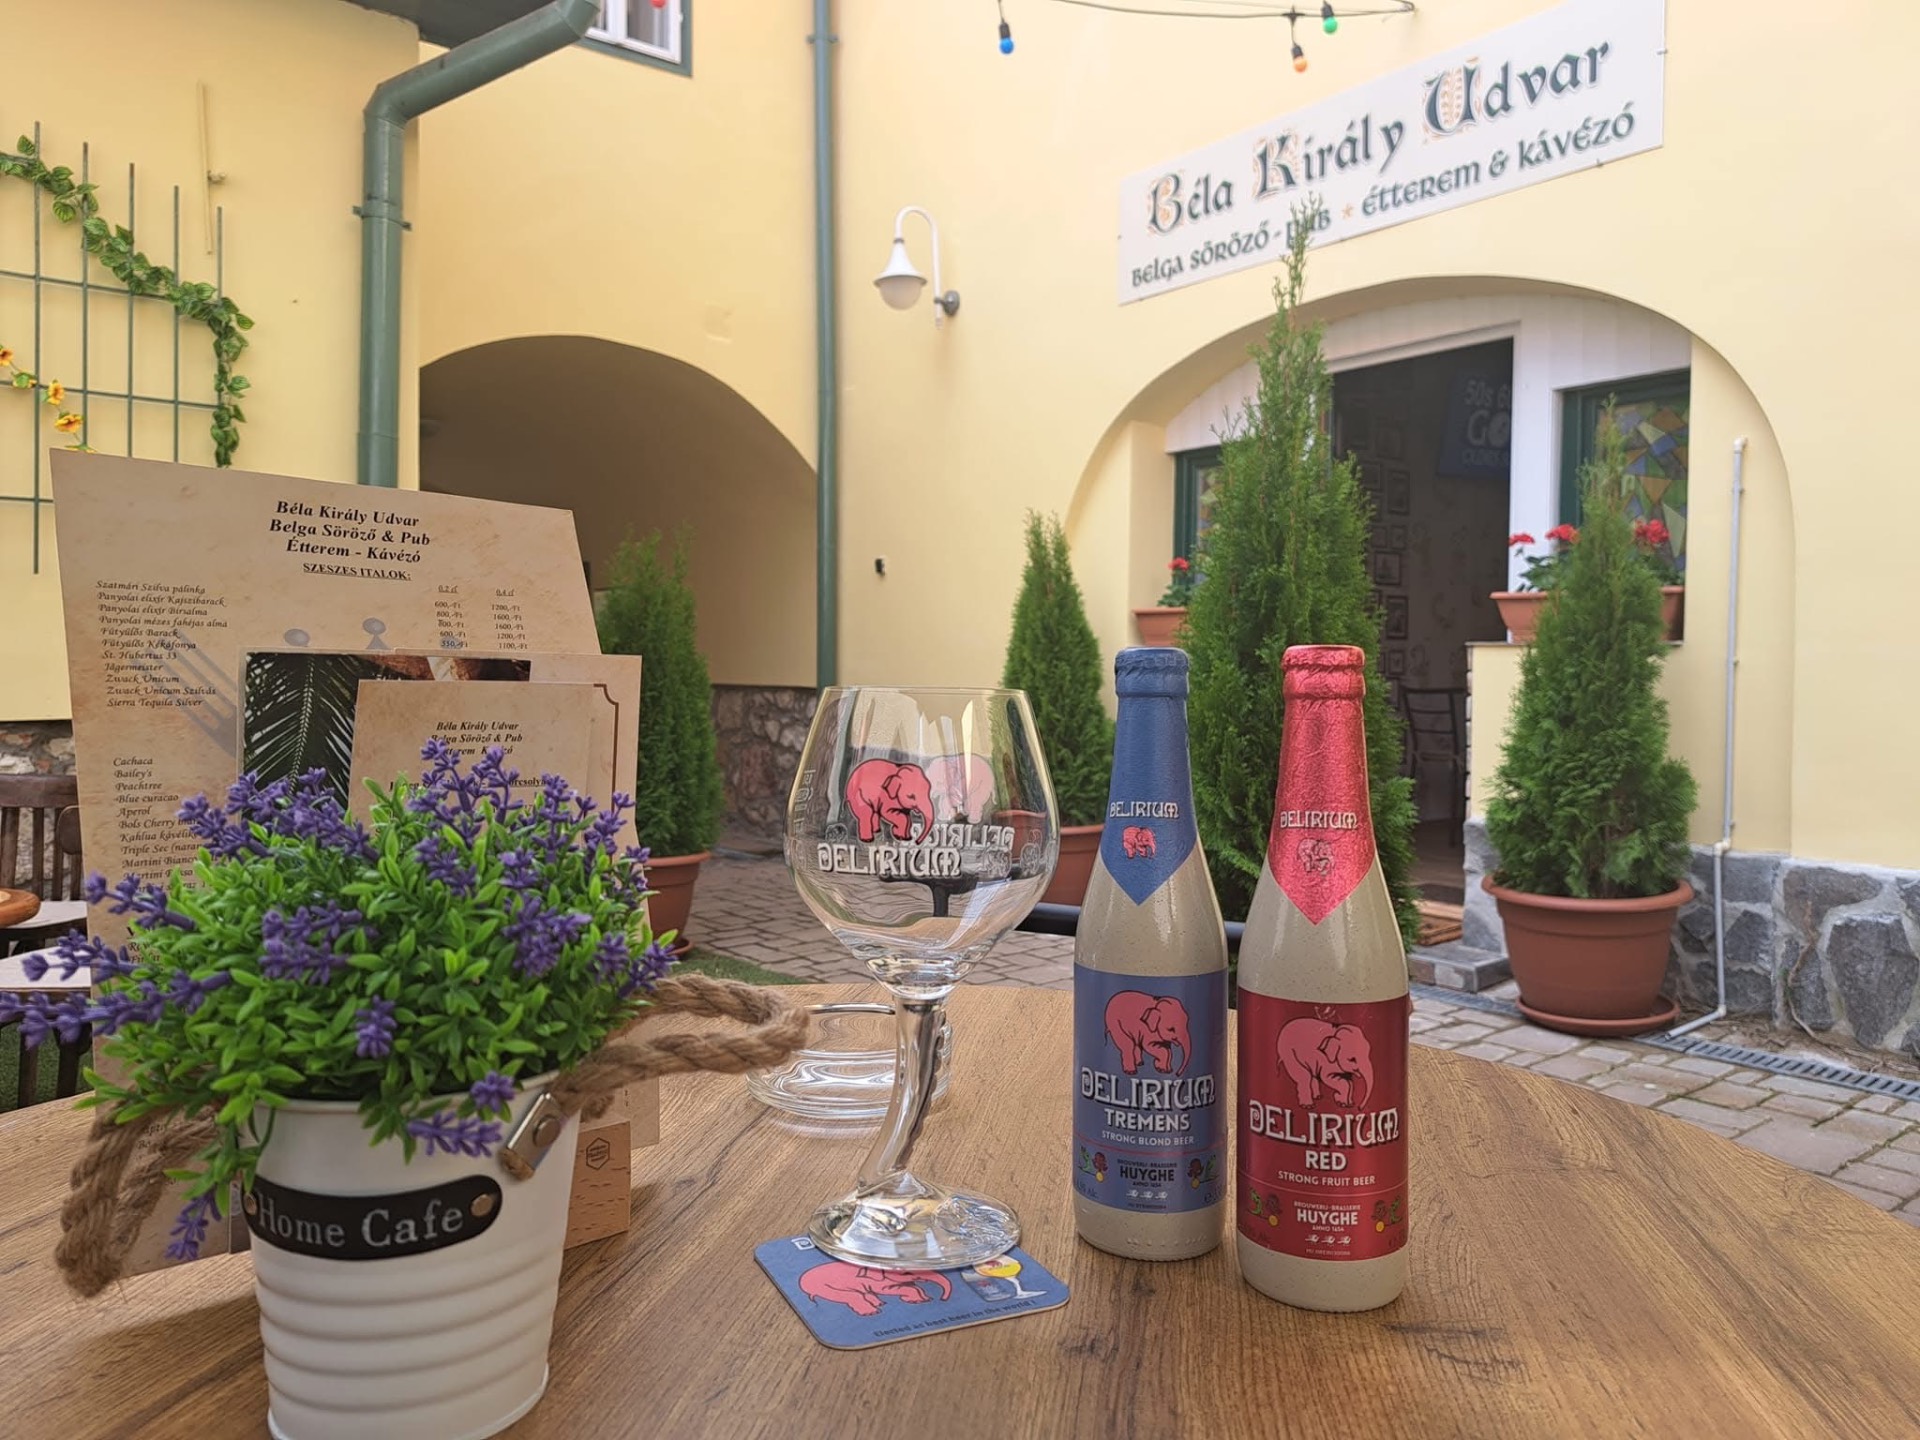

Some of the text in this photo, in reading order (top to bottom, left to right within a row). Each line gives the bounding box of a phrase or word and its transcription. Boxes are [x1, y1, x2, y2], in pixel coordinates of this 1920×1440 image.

[1148, 42, 1610, 236] Béla Király Udvar
[1489, 150, 1510, 178] &
[276, 501, 420, 527] Béla Király Udvar
[269, 519, 430, 546] Belga Söröző & Pub
[286, 536, 350, 557] Étterem
[366, 547, 421, 563] Kávézó
[303, 562, 412, 581] SZESZES ITALOK:
[96, 580, 206, 595] Szatmári Szilva pálinka
[97, 591, 139, 603] Panyolai
[98, 603, 140, 615] Panyolai
[99, 615, 141, 627] Panyolai
[143, 617, 170, 626] mézes
[206, 618, 228, 628] alma
[145, 628, 181, 639] Barack
[102, 650, 116, 660] St.
[119, 650, 163, 660] Hubertus
[104, 662, 164, 673] Jägermeister
[105, 674, 180, 684] Zwack Unicum
[106, 686, 143, 696] Zwack
[144, 686, 180, 695] Unicum
[107, 698, 204, 709] Sierra Tequila Silver
[436, 720, 519, 732] Béla Király Udvar
[493, 734, 501, 742] &
[504, 733, 523, 743] Pub
[114, 769, 152, 780] Bailey's
[115, 781, 162, 791] Peachtree
[115, 794, 140, 804] Blue
[116, 805, 152, 818] Aperol
[1110, 801, 1179, 819] DELIRIUM
[118, 818, 141, 829] Bols
[143, 818, 176, 829] Cherry
[1280, 810, 1358, 830] DELIRIUM
[120, 831, 157, 843] Kahlua
[121, 844, 150, 856] Triple
[152, 844, 169, 853] Sec
[122, 857, 162, 869] Martini
[817, 843, 963, 879] DELIRIUM
[123, 871, 163, 880] Mrtini
[1081, 1066, 1216, 1110] DELIRIUM
[1104, 1108, 1191, 1132] TREMENS
[1249, 1100, 1399, 1148] DELIRIUM
[1102, 1130, 1195, 1146] STRONG BLOND BEER
[1305, 1150, 1348, 1171] RED
[1120, 1165, 1175, 1181] HUYGHE
[1278, 1170, 1376, 1187] STRONG FRUIT BEER
[257, 1192, 464, 1248] Home Cafe
[1296, 1208, 1358, 1225] HUYGHE
[873, 1323, 911, 1337] Elected
[913, 1322, 925, 1330] as
[926, 1317, 949, 1328] best
[950, 1312, 971, 1323] beer
[972, 1310, 983, 1318] in
[984, 1305, 1000, 1315] the
[1003, 1300, 1030, 1311] world
